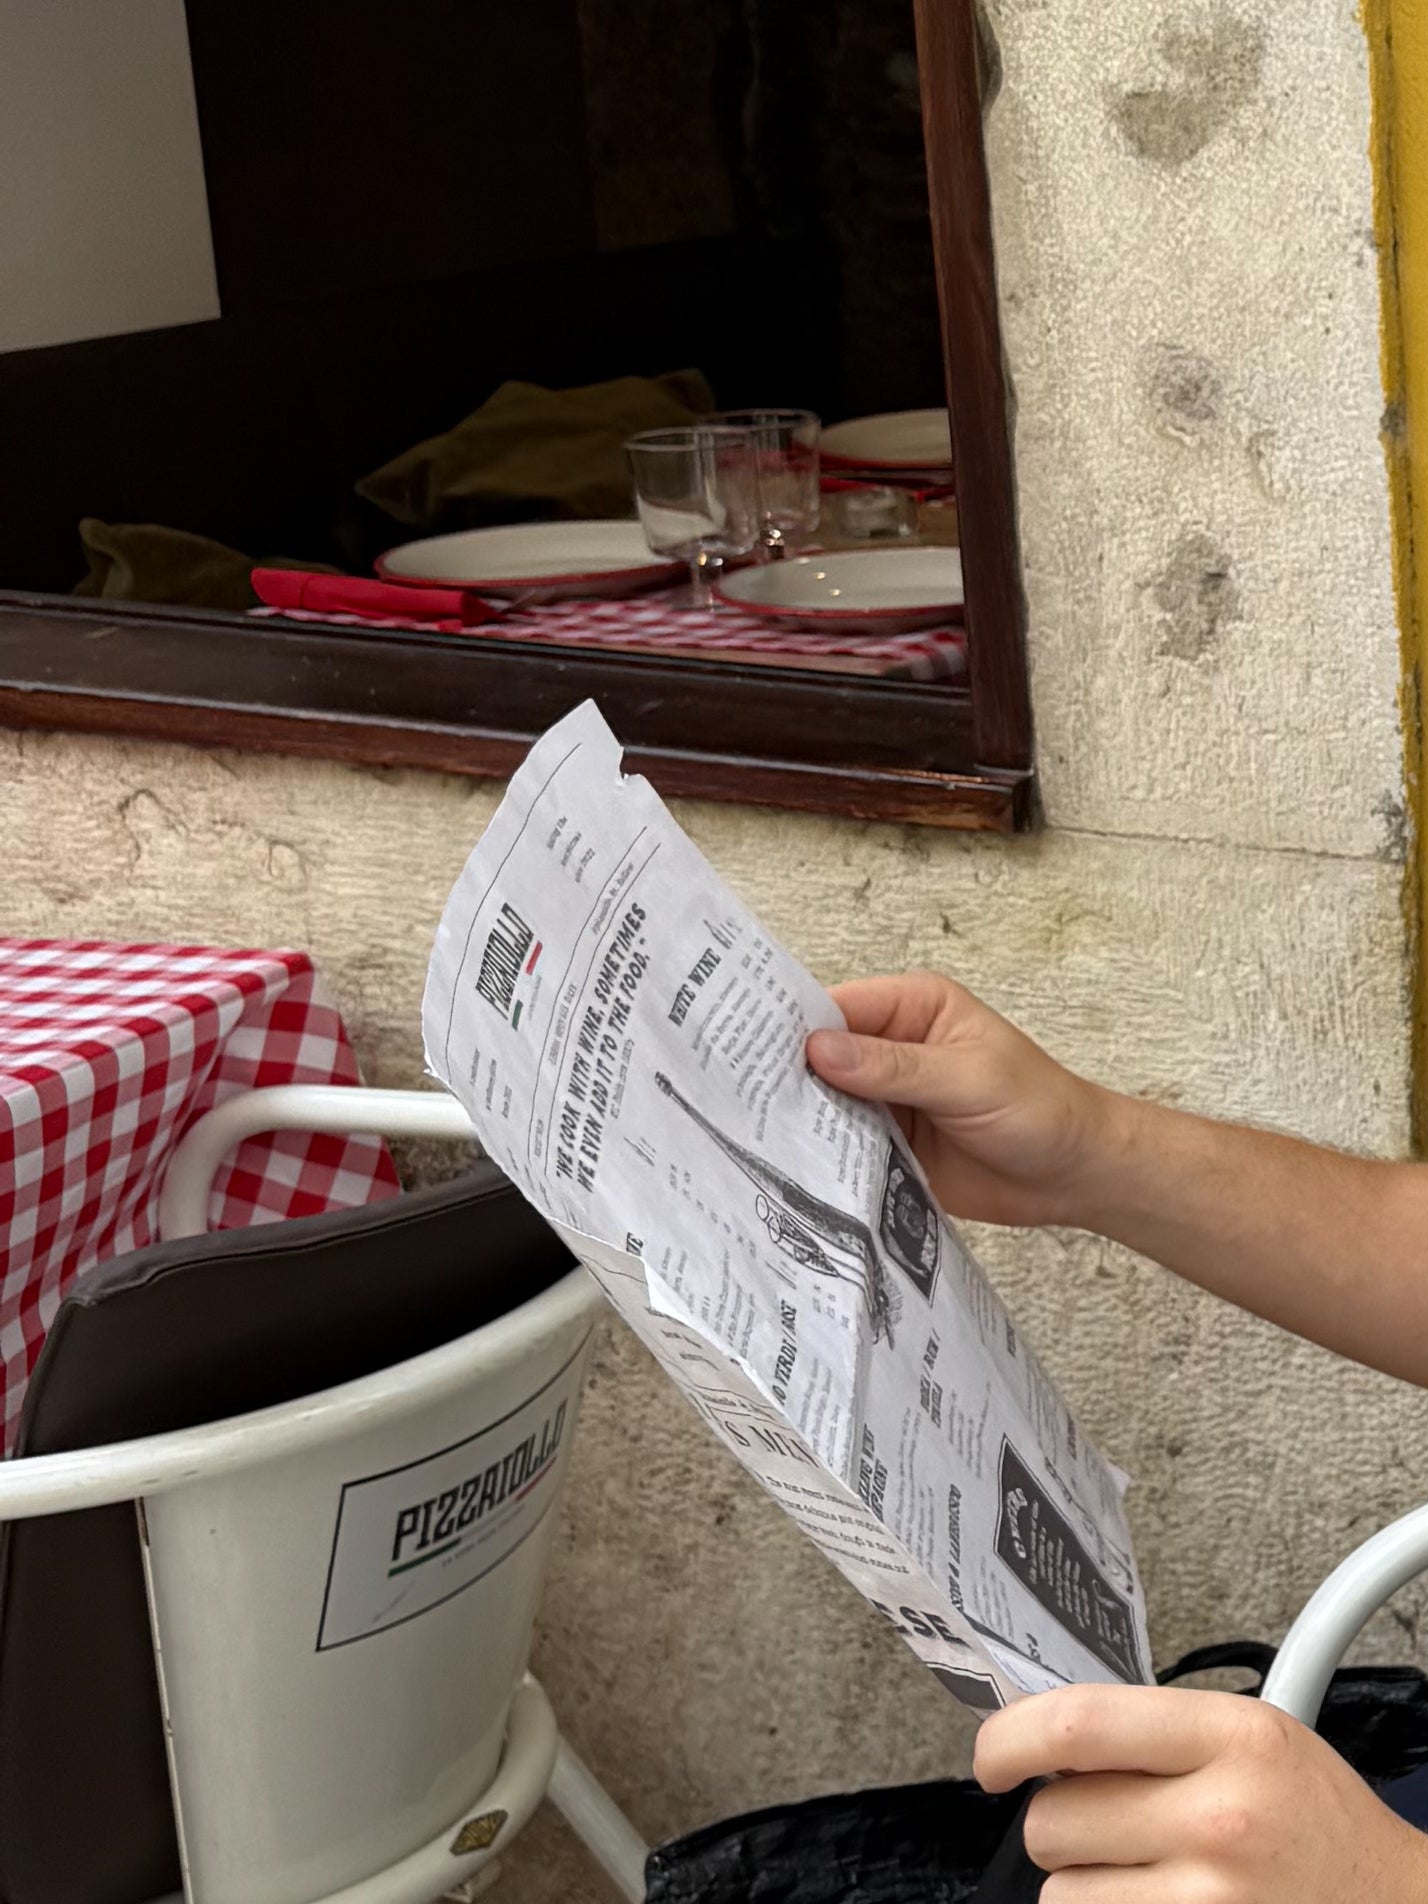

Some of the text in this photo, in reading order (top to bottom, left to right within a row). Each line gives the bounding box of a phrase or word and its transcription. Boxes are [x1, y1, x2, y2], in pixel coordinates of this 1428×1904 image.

[473, 901, 535, 1021] PIZZAIOLLO
[596, 901, 648, 1005] SOMETIMES
[666, 944, 724, 1028] WHITE WINE
[606, 995, 631, 1035] THE
[595, 1056, 614, 1084] IT
[598, 1031, 618, 1062] TO
[570, 1053, 589, 1102] WITH
[589, 1078, 611, 1120] ADD
[561, 1101, 582, 1150] COOK
[581, 1118, 605, 1163] EVEN
[576, 1158, 597, 1194] WE
[390, 1398, 569, 1562] PIZZAIOLLO
